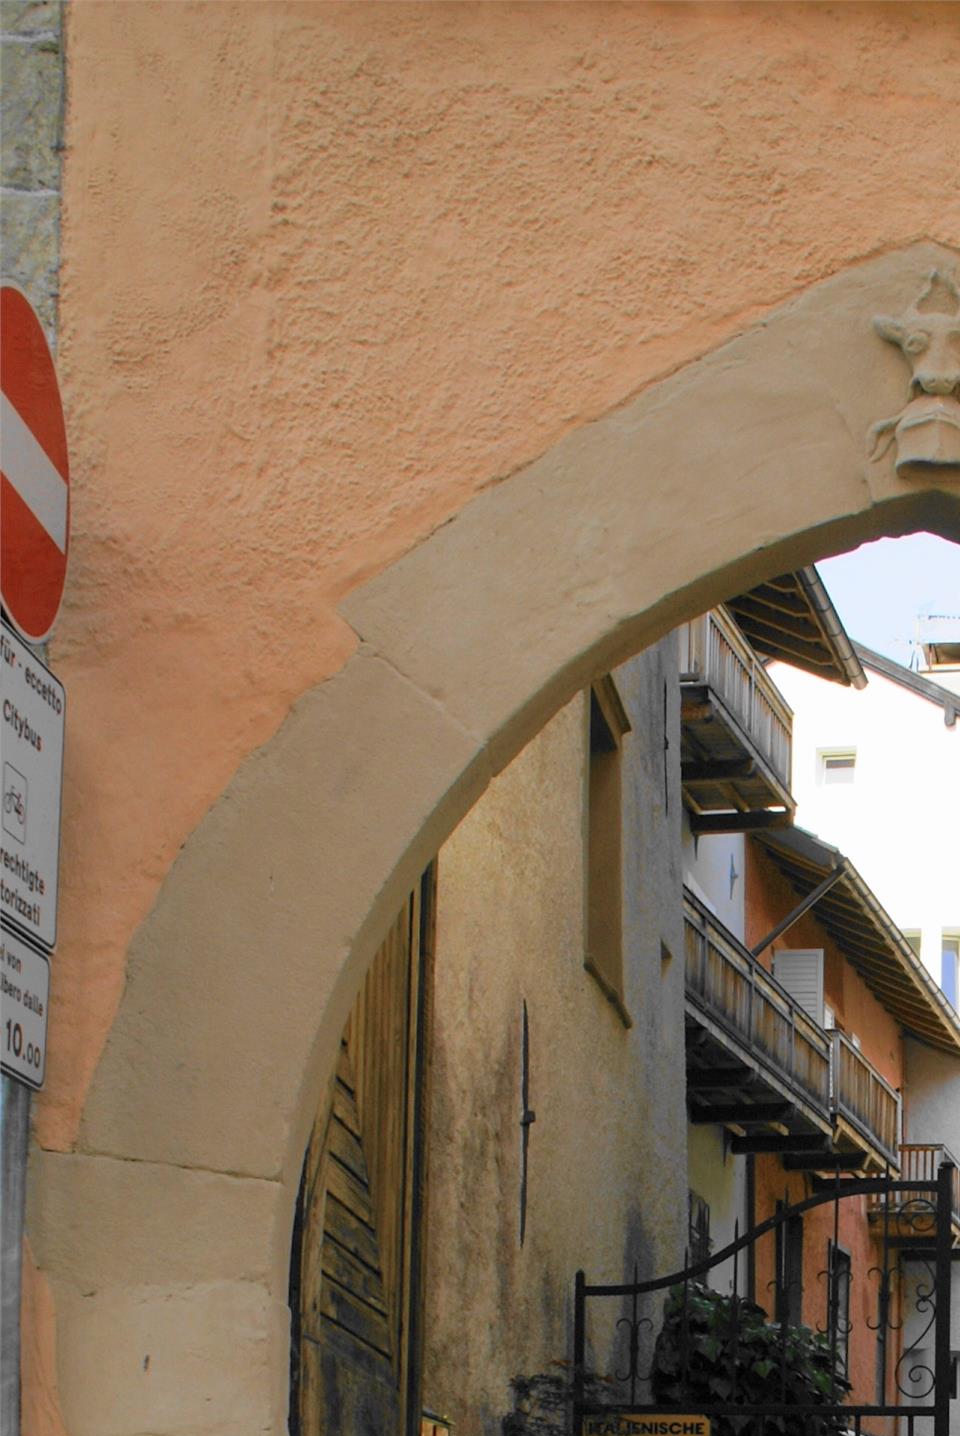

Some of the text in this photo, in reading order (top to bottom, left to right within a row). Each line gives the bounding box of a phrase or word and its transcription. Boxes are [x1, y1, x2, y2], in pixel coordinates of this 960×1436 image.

[25, 667, 63, 716] eccetto
[3, 699, 43, 754] Citybus
[6, 951, 22, 974] von
[6, 1016, 41, 1069] 10.00
